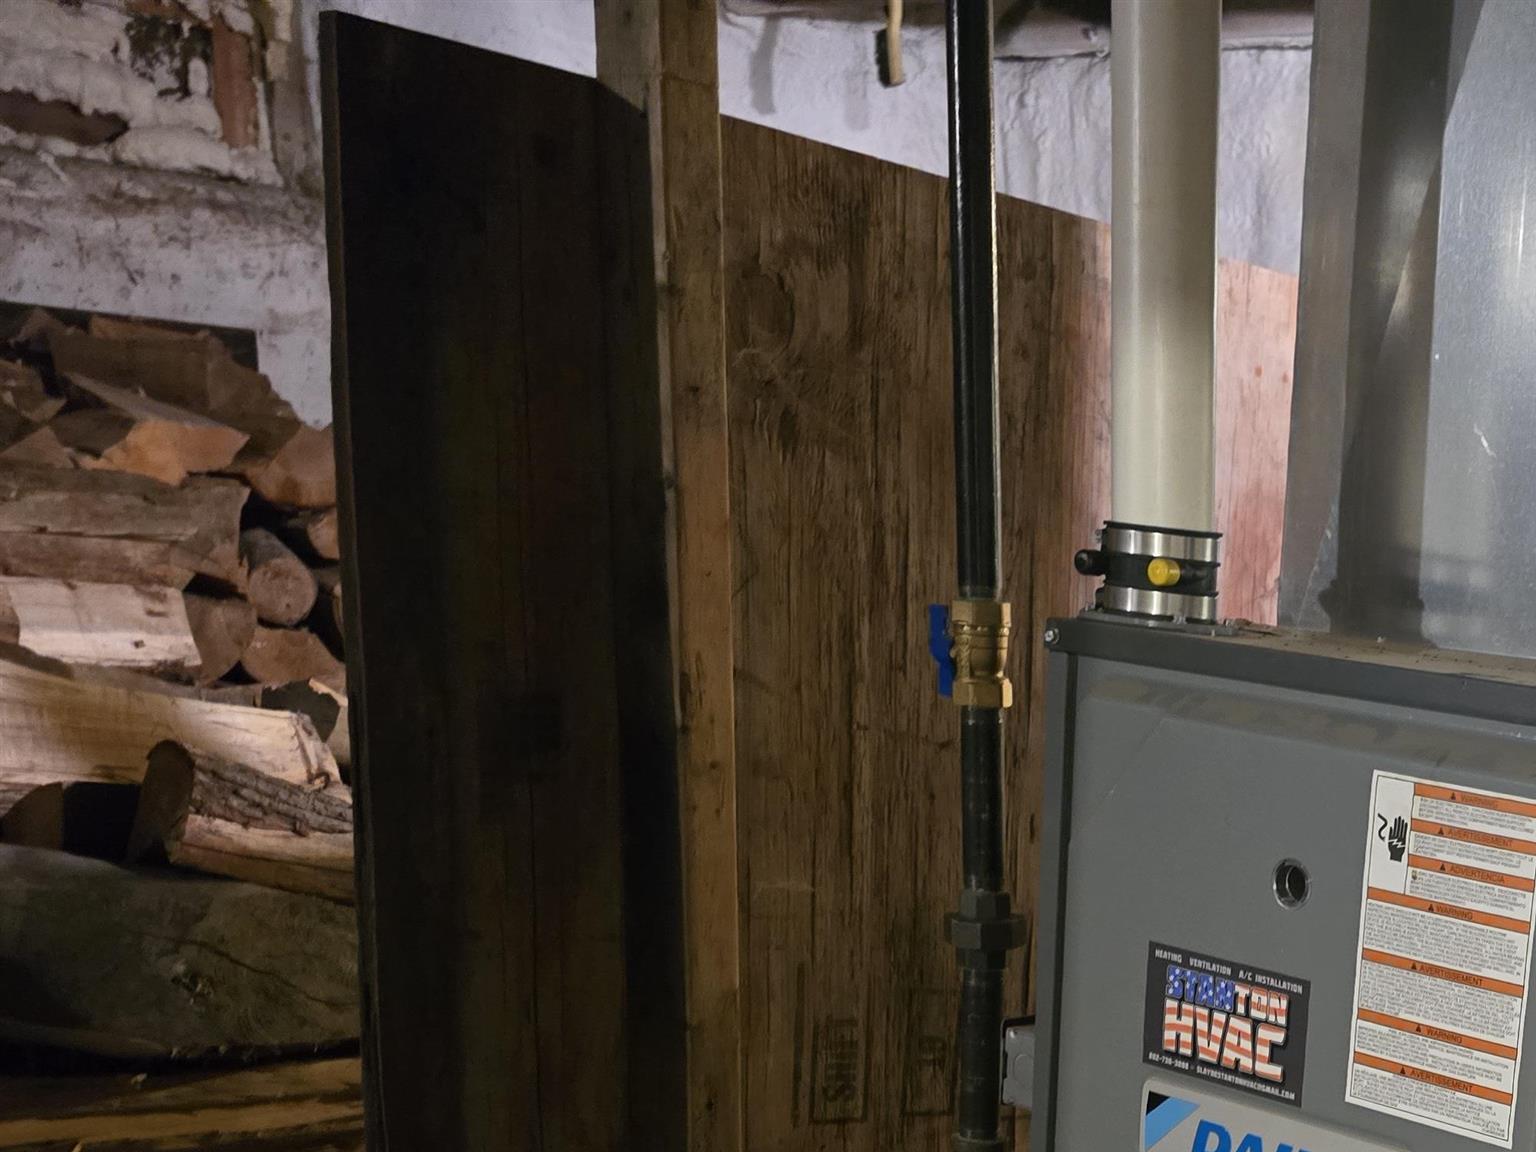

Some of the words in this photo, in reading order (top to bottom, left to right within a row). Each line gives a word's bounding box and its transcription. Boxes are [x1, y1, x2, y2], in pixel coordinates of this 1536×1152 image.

[1450, 865, 1505, 883] ADVERTENCIA
[1436, 906, 1473, 920] WARNING
[1155, 949, 1183, 963] HEATING
[1189, 957, 1232, 976] VENTILATION
[1238, 969, 1252, 981] A/C
[1255, 974, 1303, 994] INSTALLATION
[1418, 965, 1483, 987] AVERTISSEMENT
[1166, 964, 1289, 1027] STANTON
[1162, 997, 1288, 1083] HVAC
[1425, 1028, 1463, 1044] WARNING
[1410, 1069, 1473, 1092] AVERTISSEMENT
